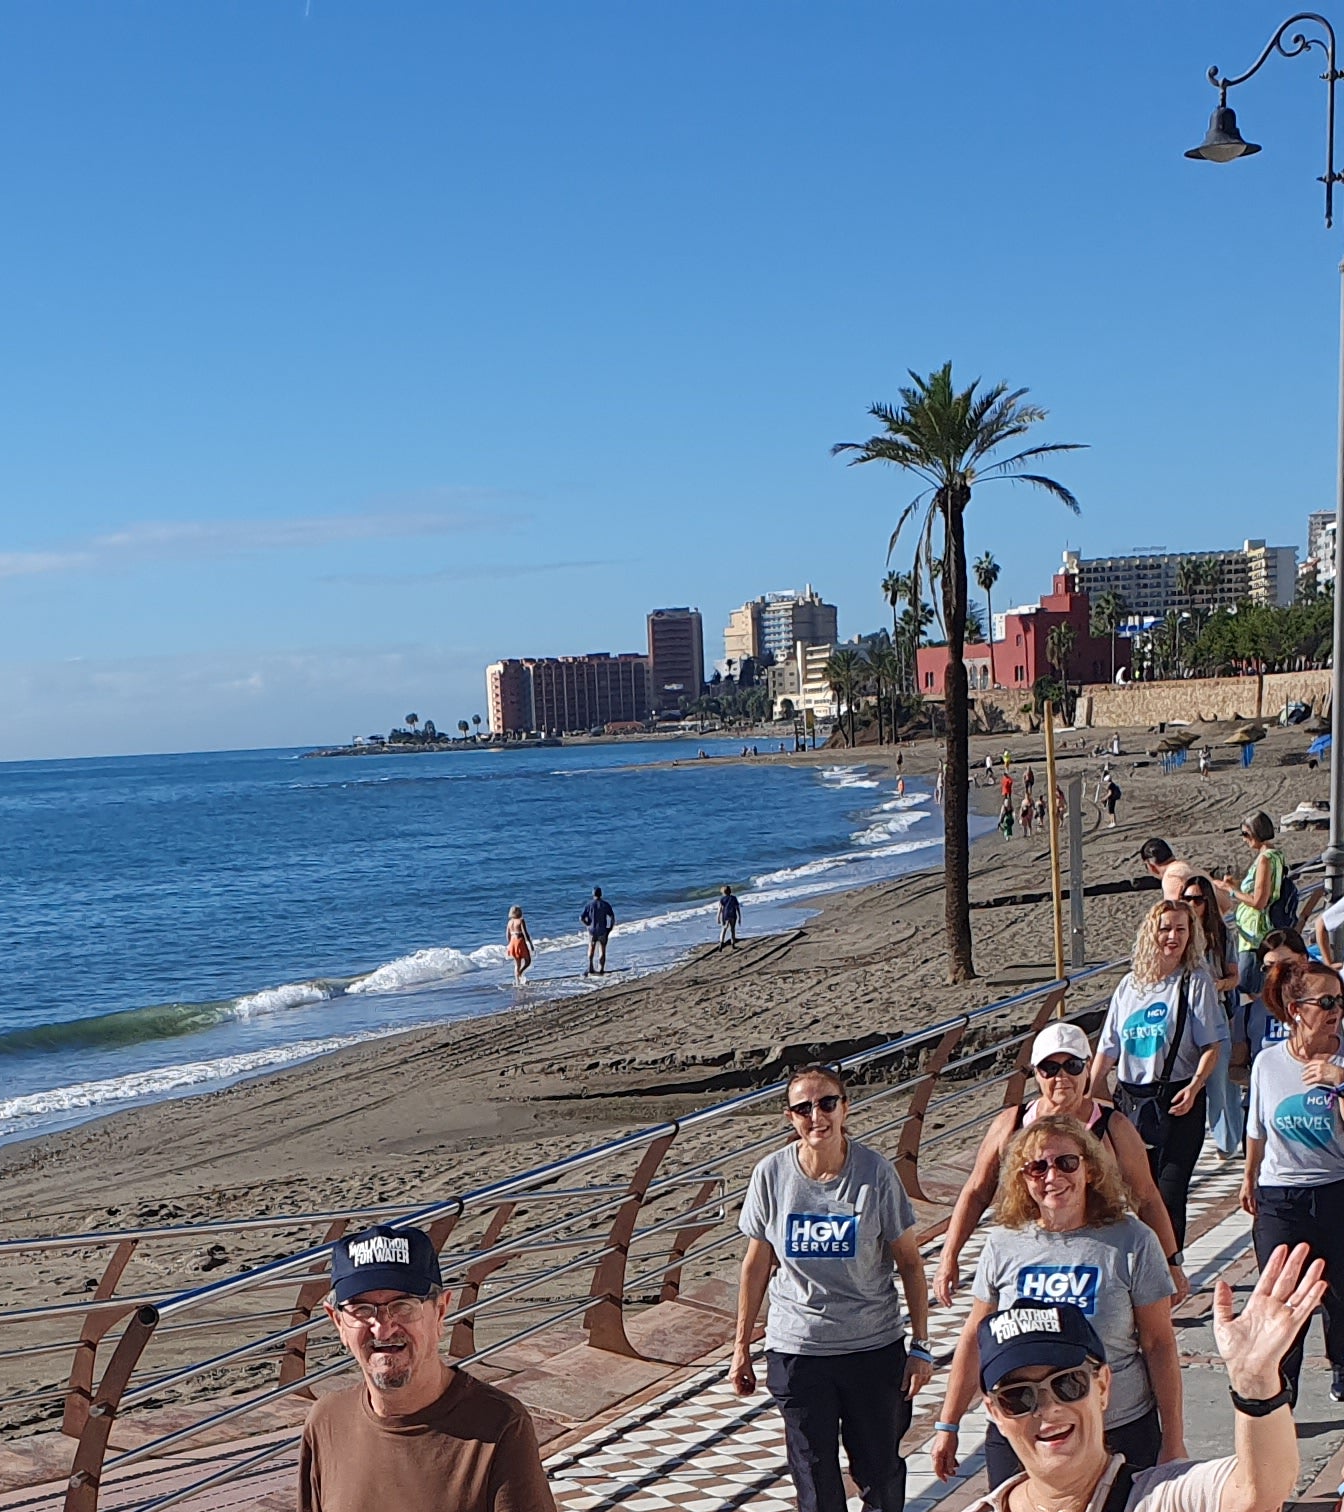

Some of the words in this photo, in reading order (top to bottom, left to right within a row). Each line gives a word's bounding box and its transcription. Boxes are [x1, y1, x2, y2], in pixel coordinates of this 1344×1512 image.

[1147, 1009, 1165, 1018] HGV
[1122, 1024, 1164, 1040] SERVES
[1276, 1115, 1331, 1130] SERVES
[791, 1220, 849, 1242] HGV
[348, 1235, 409, 1259] WALKATHON
[791, 1241, 850, 1252] SERVES
[354, 1251, 374, 1268] FOR
[373, 1249, 410, 1265] WATER
[1023, 1272, 1091, 1297] HGV
[996, 1321, 1021, 1344] FOR
[1017, 1319, 1061, 1334] WATER
